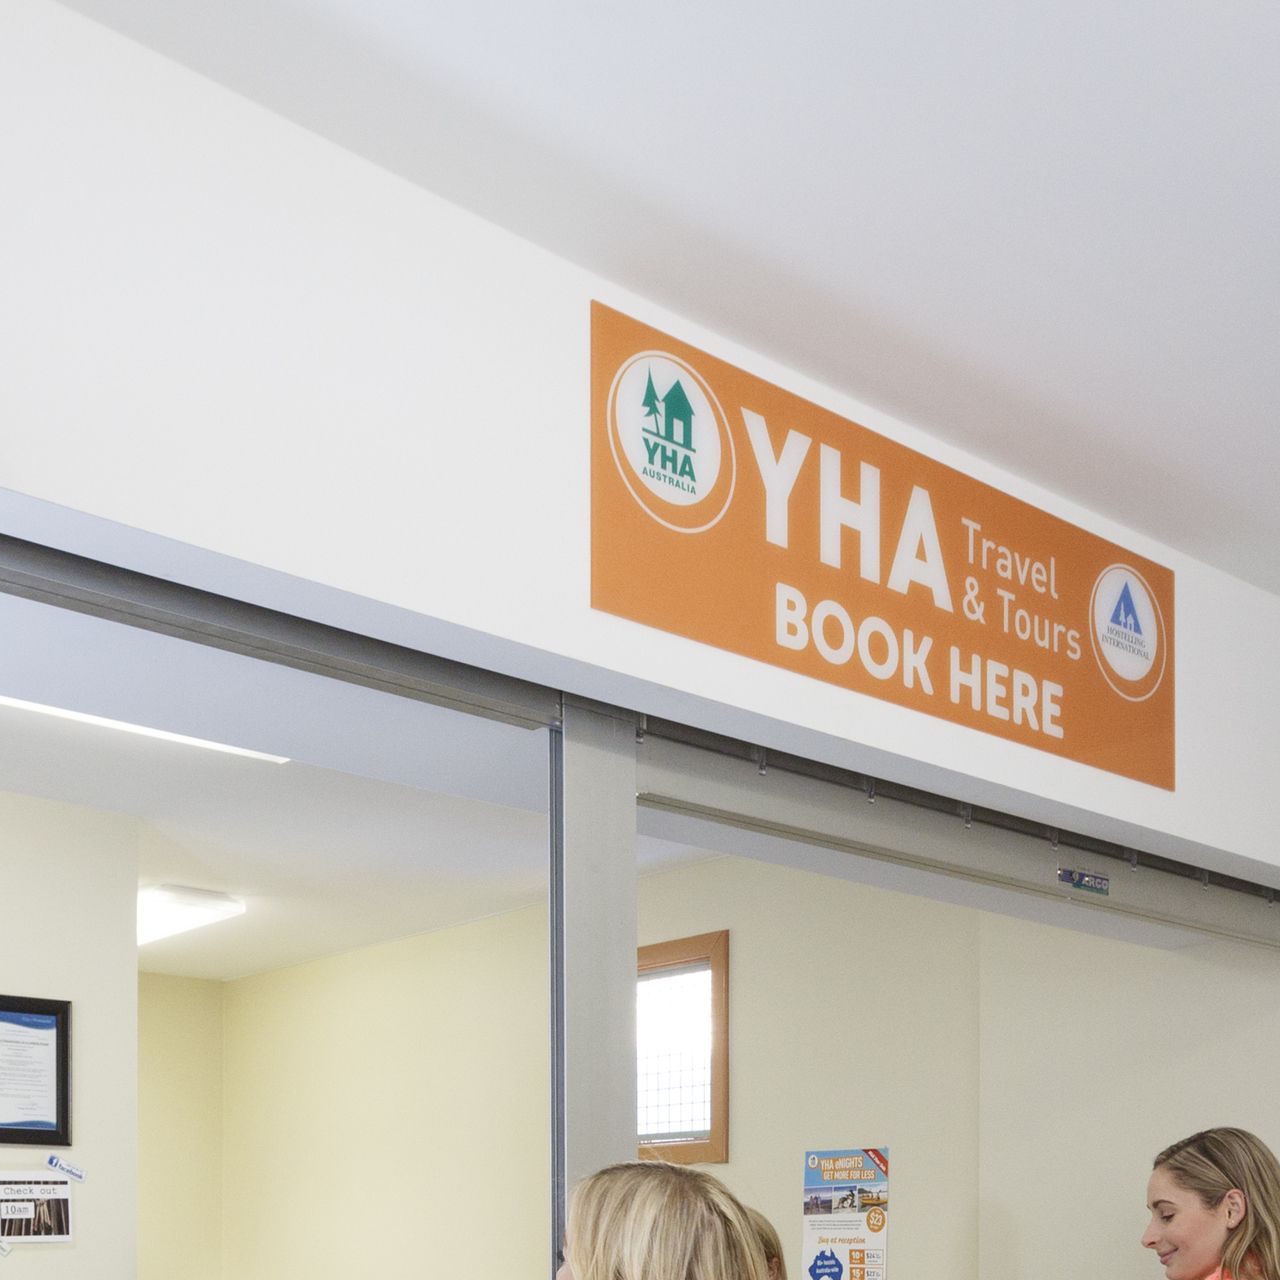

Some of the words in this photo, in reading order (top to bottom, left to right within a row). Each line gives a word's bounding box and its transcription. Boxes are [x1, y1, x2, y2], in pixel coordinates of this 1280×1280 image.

[642, 436, 696, 482] YHA
[642, 467, 696, 495] AUSTRALIA
[740, 406, 955, 614] YHA
[961, 517, 1058, 599] Travel
[962, 576, 985, 625] &
[996, 587, 1081, 660] Tours
[1101, 634, 1151, 661] INTERNATIONAL
[1107, 626, 1146, 648] HOSTELLING
[775, 581, 934, 696] BOOK
[949, 645, 1064, 739] HERE
[58, 1164, 83, 1180] facebook
[821, 1158, 835, 1171] YHA
[835, 1156, 863, 1169] eNIGHTS
[823, 1170, 833, 1180] GET
[834, 1169, 849, 1180] MORE
[850, 1169, 860, 1179] FOR
[861, 1169, 875, 1179] LESS
[3, 1187, 34, 1195] Check
[40, 1187, 57, 1195] out
[5, 1205, 29, 1215] 10am
[838, 1236, 866, 1245] reception
